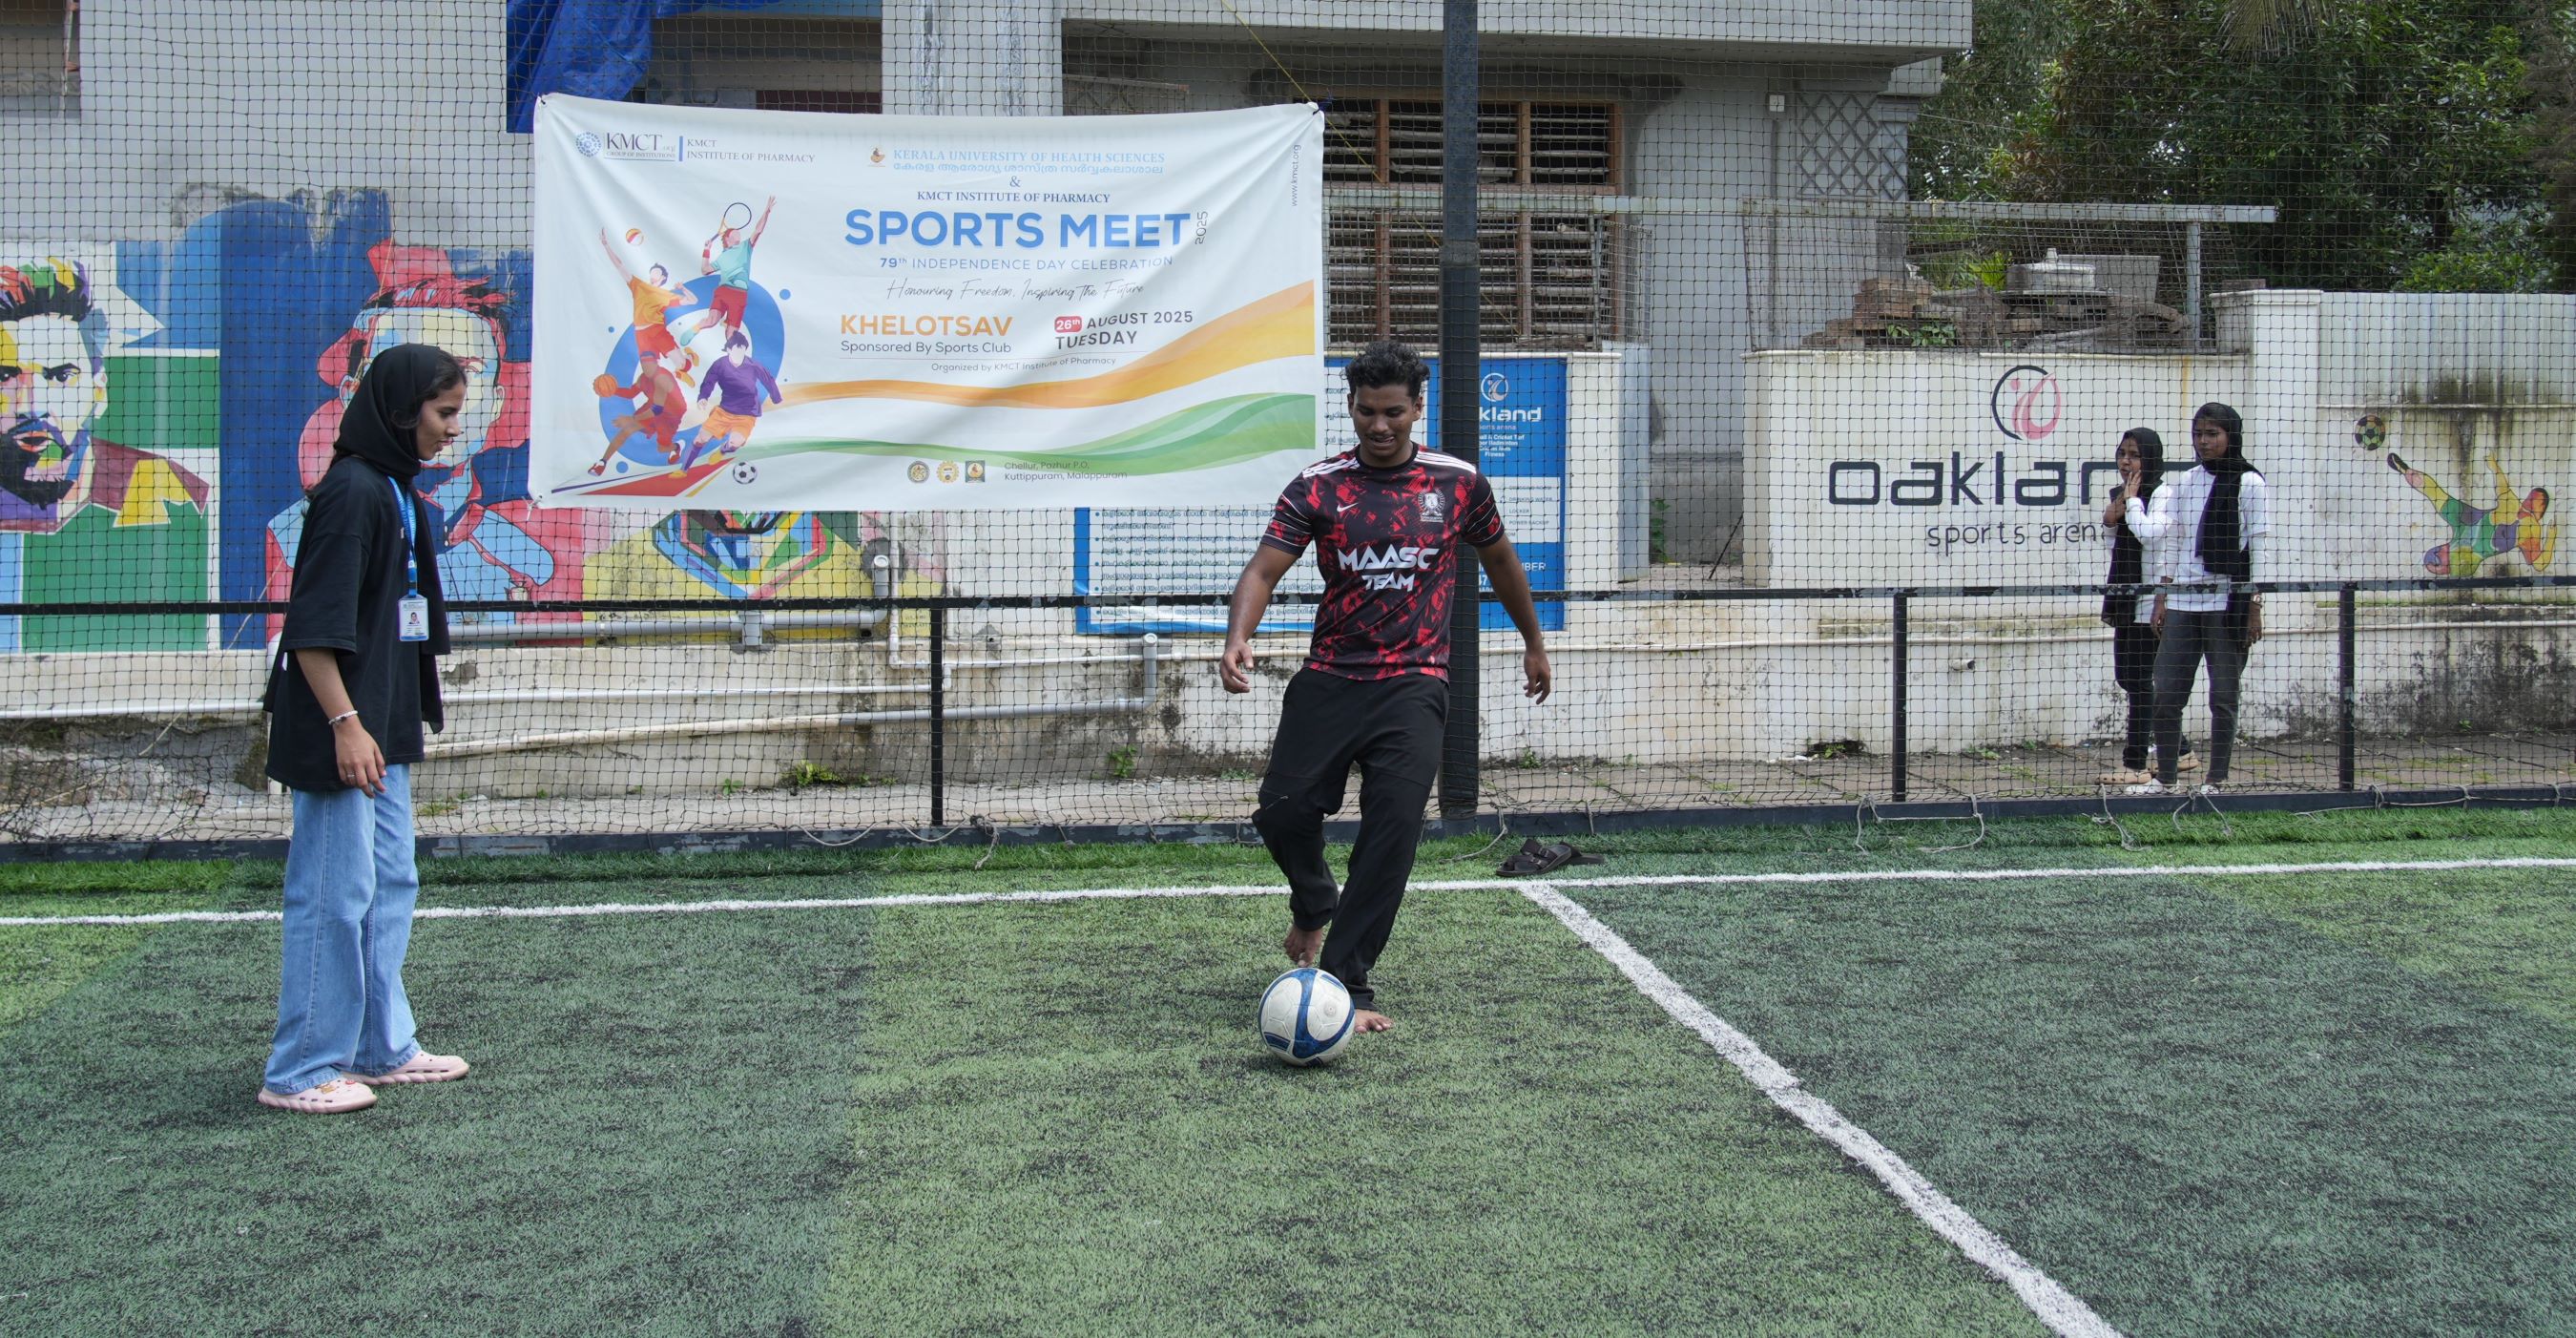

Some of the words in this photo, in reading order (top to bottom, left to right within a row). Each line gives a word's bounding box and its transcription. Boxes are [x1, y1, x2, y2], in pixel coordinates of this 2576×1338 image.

[687, 138, 717, 148] KMCT
[687, 150, 740, 160] INSTITUTE
[741, 152, 755, 161] OF
[758, 153, 816, 163] PHARMACY
[893, 149, 945, 160] KERALA
[949, 151, 1027, 161] UNIVERSITY
[1030, 152, 1048, 161] OF
[1051, 152, 1102, 162] HEALTH
[1105, 153, 1165, 163] SCIENCES
[1008, 176, 1021, 187] &
[1291, 144, 1301, 207] www.kmct.org
[917, 191, 952, 201] KMCT
[955, 192, 1020, 202] INSTITUTE
[1024, 193, 1041, 202] OF
[1043, 193, 1111, 203] PHARMACY
[845, 208, 1044, 248] SPORTS
[1060, 213, 1191, 248] MEET
[1195, 211, 1209, 245] 2025
[880, 258, 907, 268] 79th
[912, 258, 1030, 270] INDEPENDENCE
[1036, 259, 1068, 270] DAY
[1070, 255, 1174, 270] CELEBRATION
[886, 277, 953, 301] Honouring
[1021, 278, 1075, 301] Inspiring
[1103, 278, 1145, 299] Future
[841, 314, 1013, 337] KHELOTSAV
[1055, 318, 1081, 331] 26th
[1086, 312, 1149, 329] AUGUST
[1153, 310, 1194, 324] 2025
[841, 340, 911, 354] Sponsored
[916, 341, 932, 355] By
[935, 342, 979, 355] Sports
[982, 342, 1011, 353] Club
[1055, 330, 1137, 350] TUESDAY
[931, 362, 979, 373] Organized
[981, 362, 991, 372] by
[1022, 359, 1057, 370] Institute
[1059, 357, 1070, 366] of
[1070, 356, 1116, 366] Pharmacy
[1479, 406, 1542, 423] kland
[1005, 472, 1065, 482] Kuttippuram,
[1067, 472, 1128, 481] Malappuram
[1926, 519, 2025, 556] sports
[1337, 543, 1442, 571] MAASC
[1361, 572, 1416, 593] TEAM
